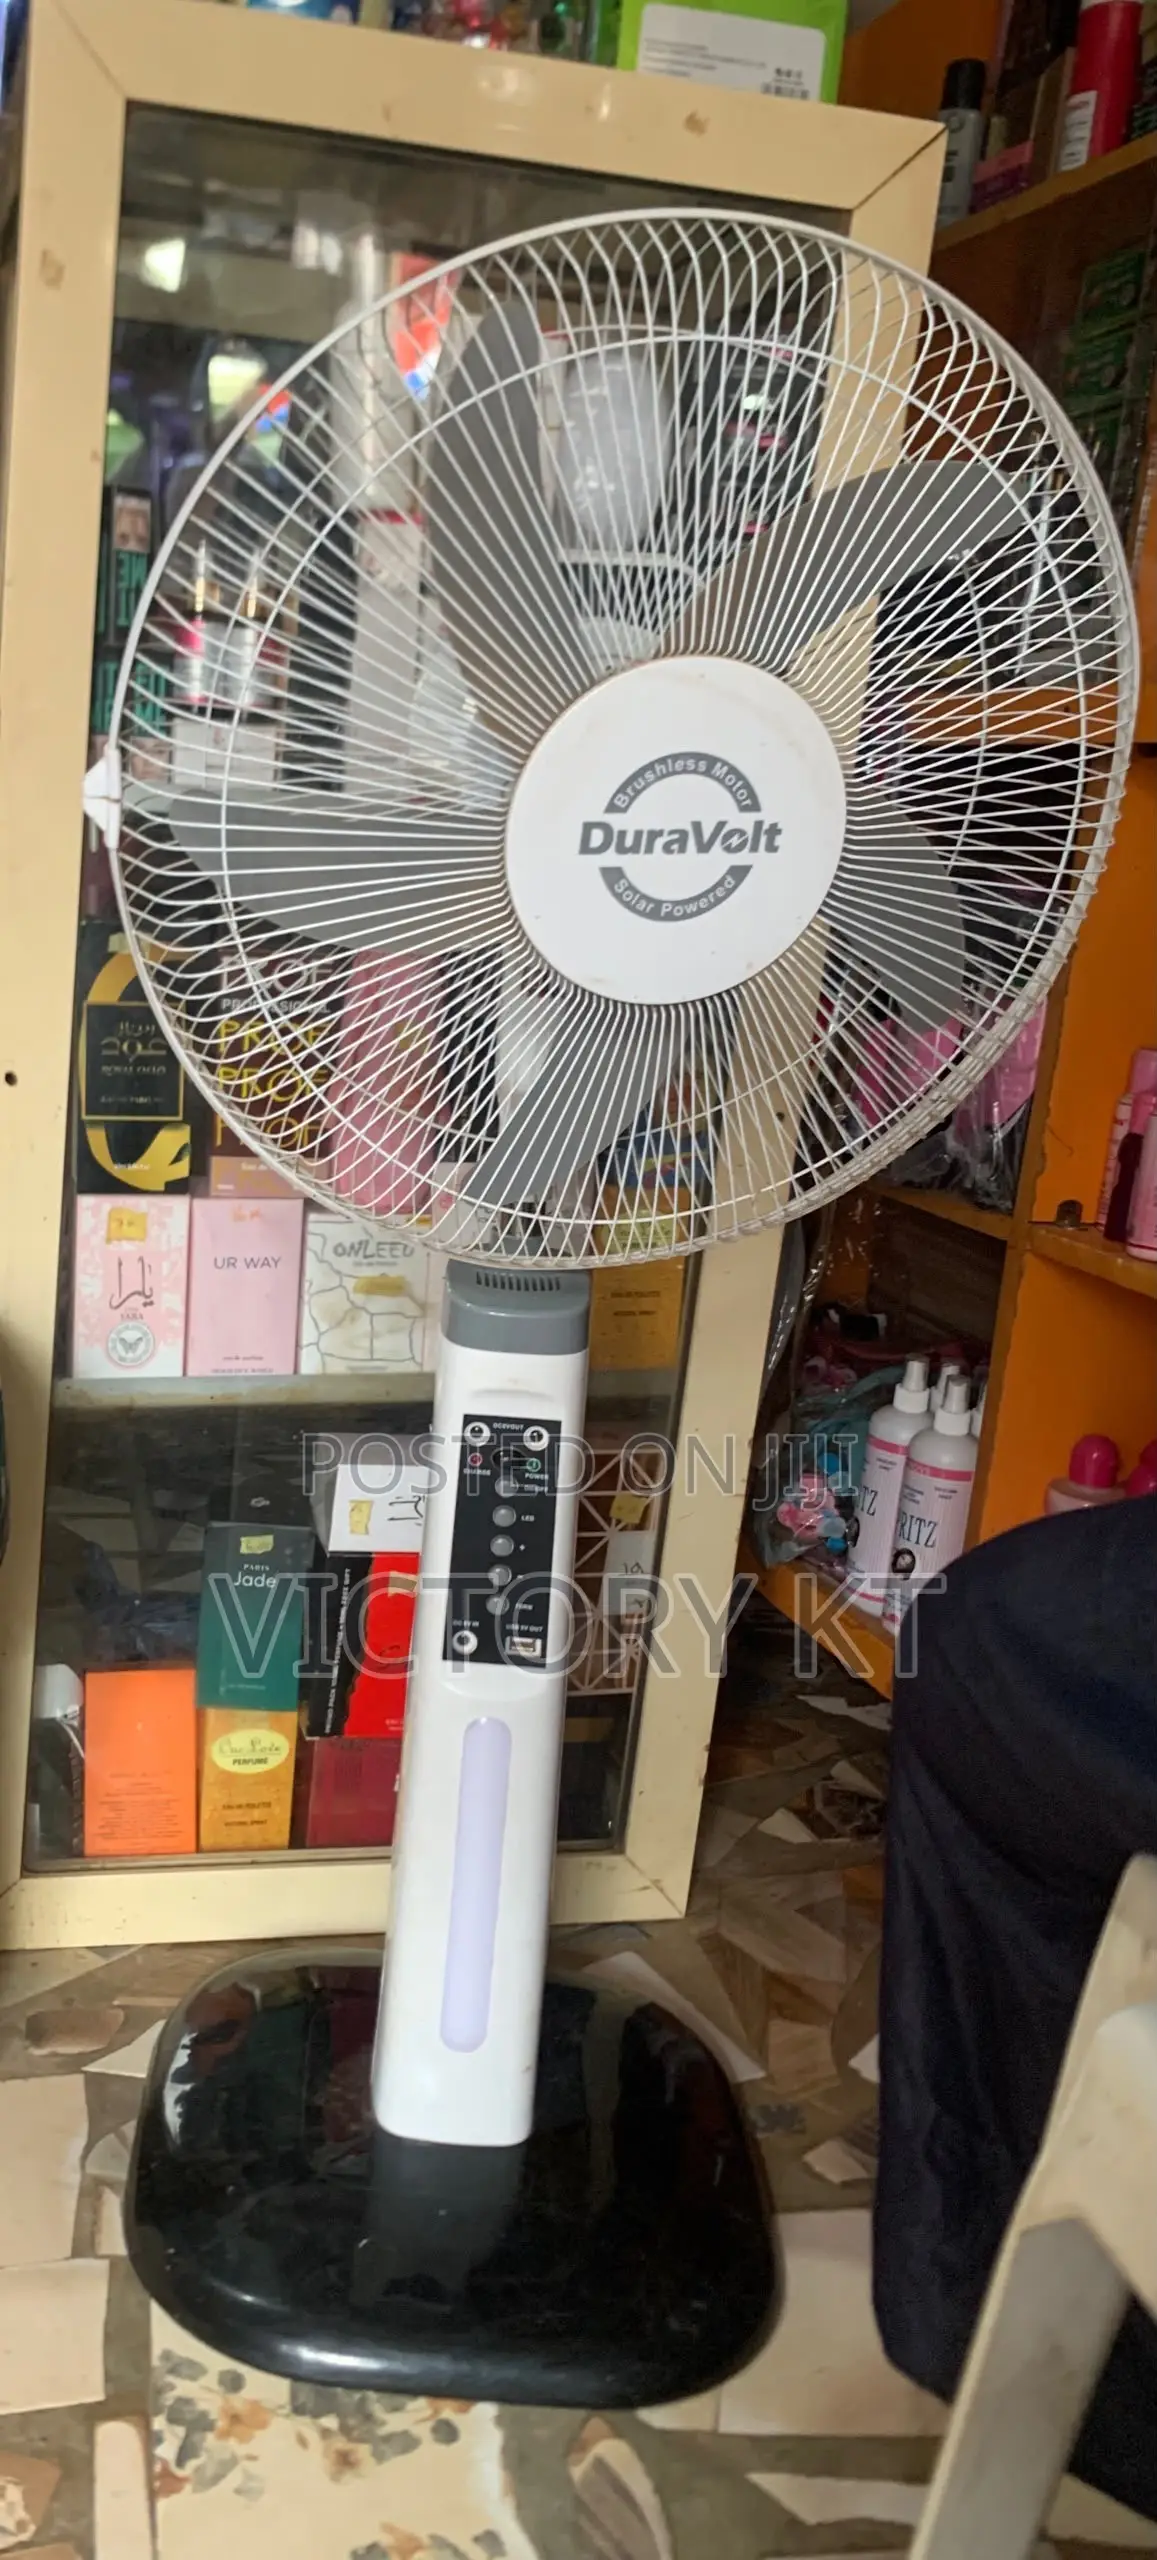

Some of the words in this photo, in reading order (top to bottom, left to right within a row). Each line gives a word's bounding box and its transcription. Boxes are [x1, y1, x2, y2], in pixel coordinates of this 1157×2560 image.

[613, 758, 708, 808] Brushless
[711, 761, 752, 807] Motor
[578, 820, 783, 856] DuraVolt
[614, 878, 654, 914] Solar
[660, 875, 736, 917] Powered
[213, 1257, 237, 1270] UR
[244, 1257, 282, 1269] WAY
[234, 1571, 276, 1588] Jade
